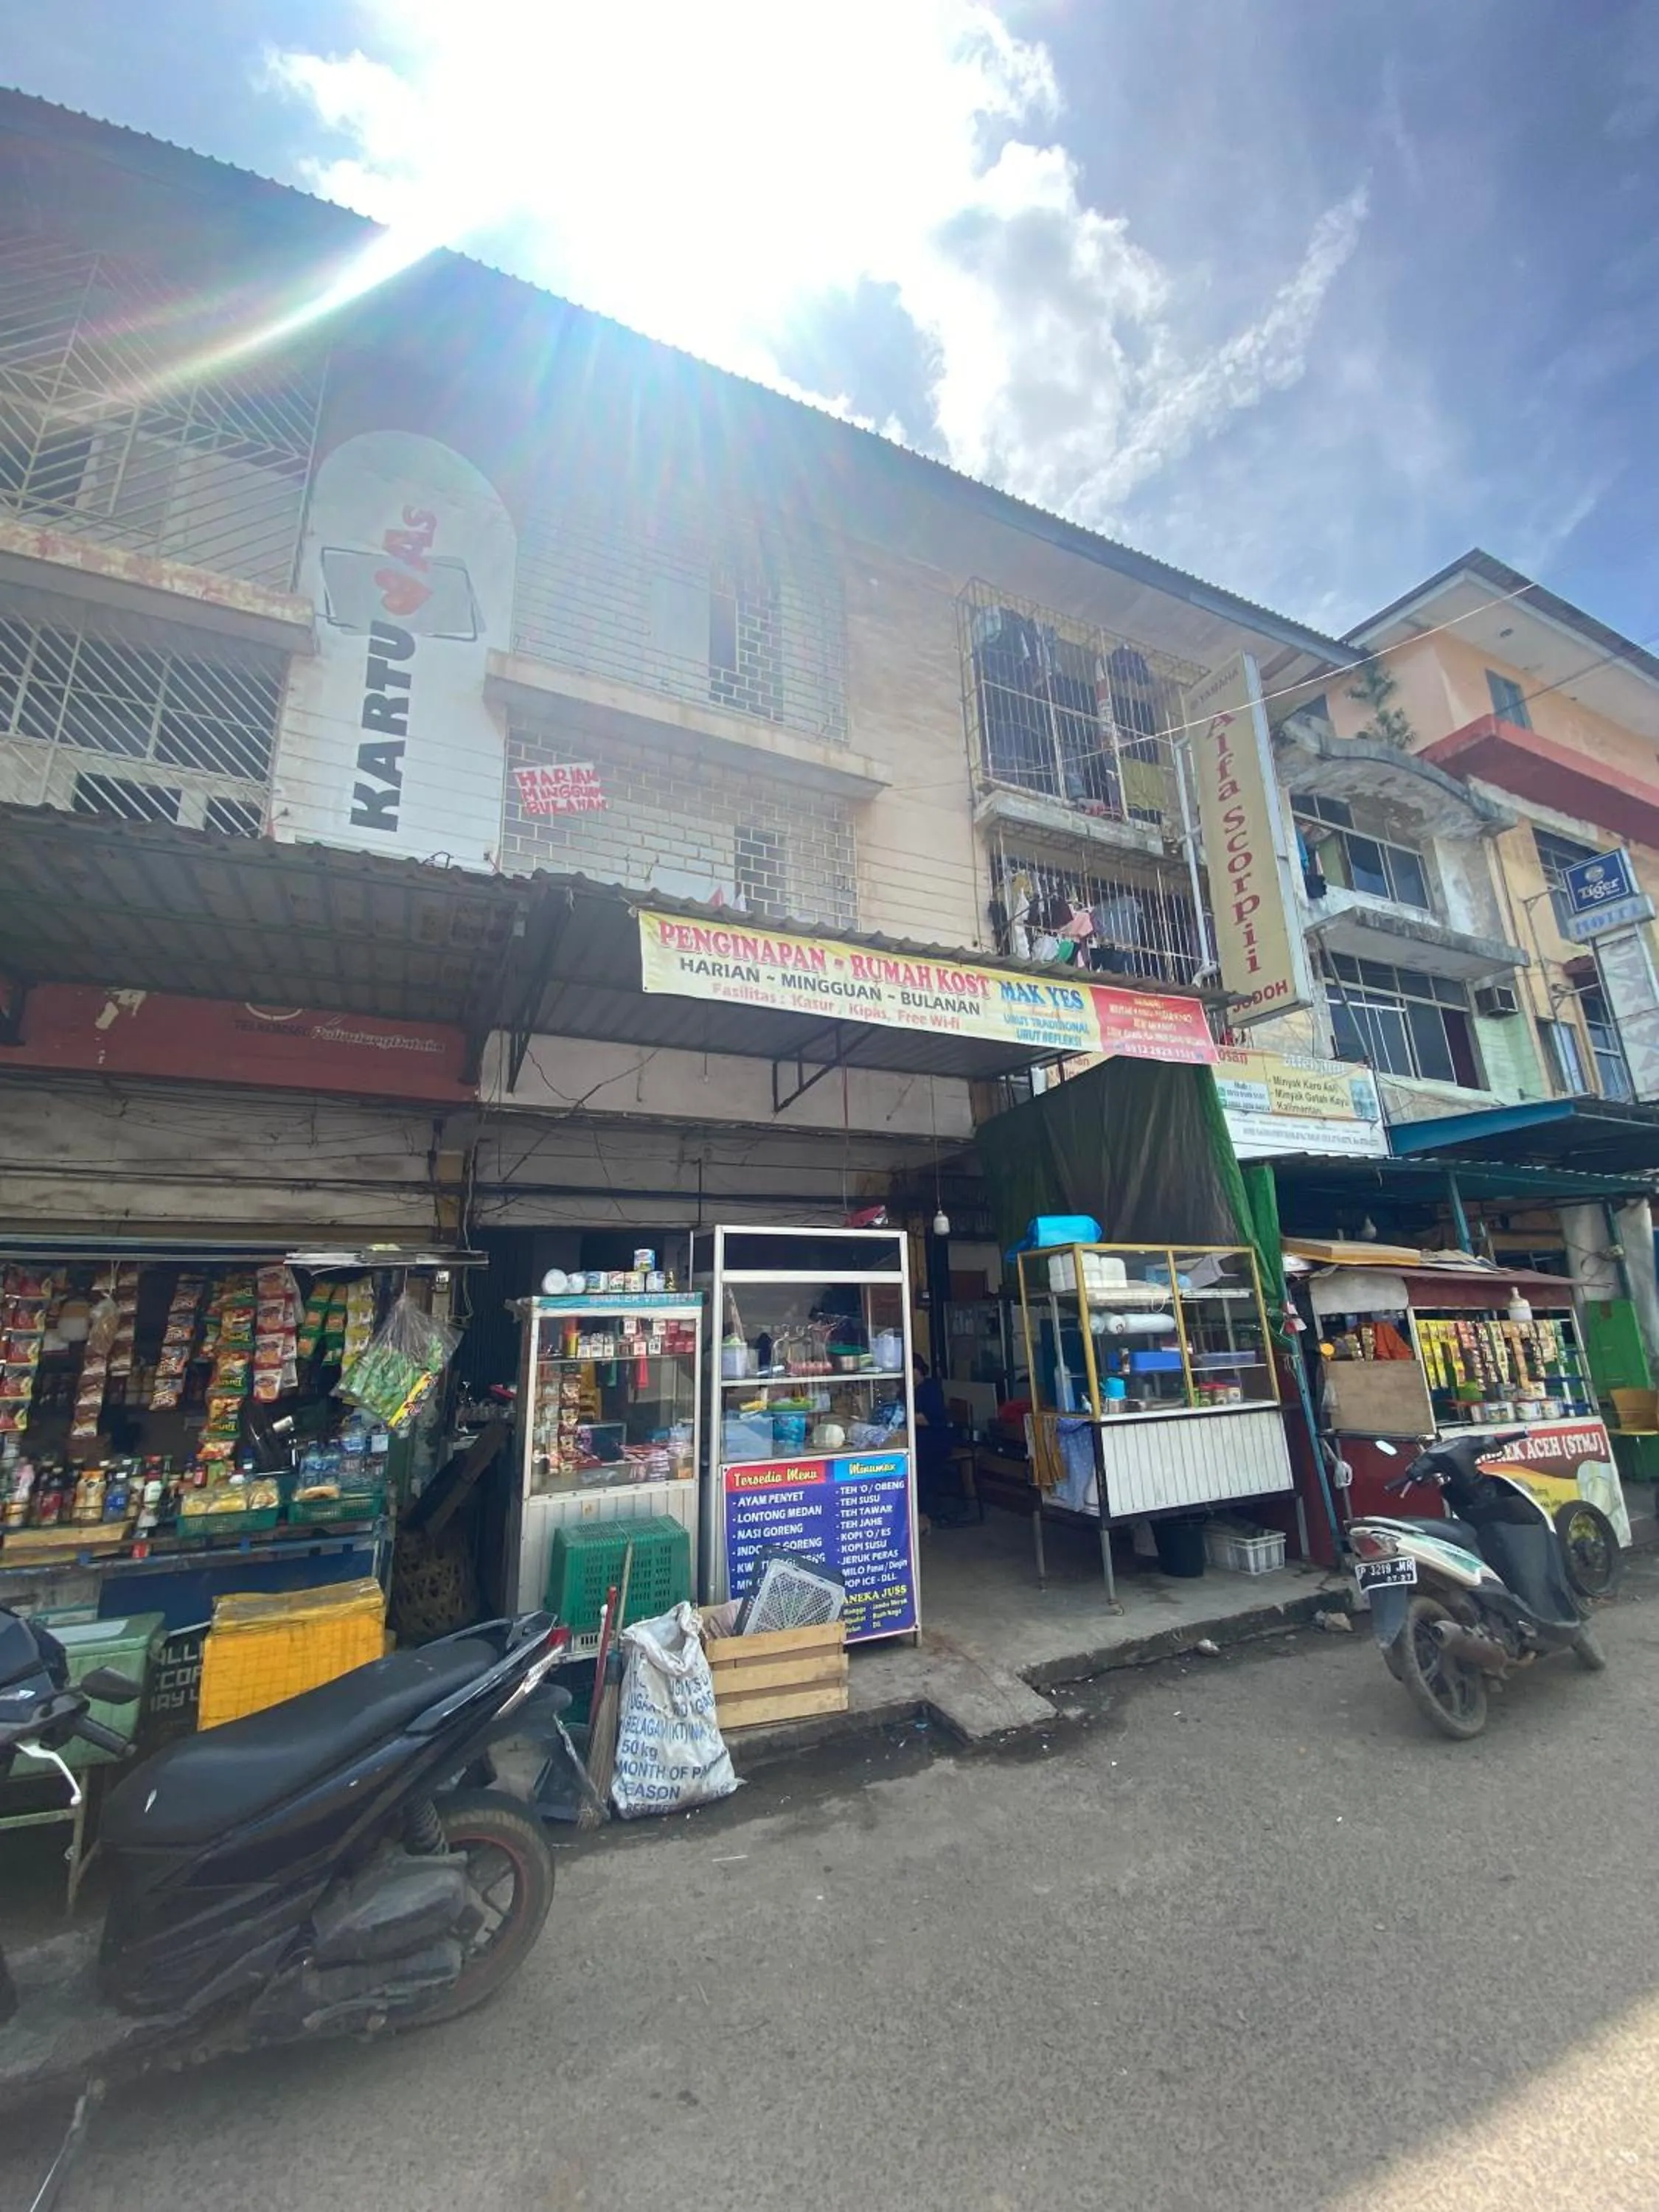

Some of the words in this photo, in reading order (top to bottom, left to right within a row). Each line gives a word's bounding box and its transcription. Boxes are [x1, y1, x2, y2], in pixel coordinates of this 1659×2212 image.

[1200, 666, 1239, 703] YAMAHA
[350, 619, 416, 832] KARTU
[1206, 709, 1242, 803] Alfa
[517, 766, 599, 785] HARIAN
[521, 785, 604, 801] MINGGUAN
[526, 796, 608, 814] BULANAN
[1222, 804, 1262, 974] Scorpii
[1577, 877, 1620, 899] Tiger
[658, 920, 827, 974] PENGINAPAN
[849, 953, 933, 992] RUMAH
[936, 967, 992, 1000] KOST
[999, 981, 1046, 1006] MAK
[1044, 986, 1085, 1011] YES
[679, 957, 760, 983] HARIAN
[782, 972, 883, 1001] MINGGUAN
[900, 991, 980, 1015] BULANAN
[712, 982, 776, 1004] Fasilitas
[897, 1009, 928, 1025] Free
[1015, 1027, 1040, 1040] URUT
[1273, 1074, 1301, 1089] Minyak
[1275, 1088, 1304, 1102] Minyak
[1527, 1436, 1562, 1459] ACEH
[734, 1470, 782, 1487] Tersedia
[787, 1468, 818, 1482] Menu
[841, 1486, 858, 1495] TEH
[874, 1480, 905, 1492] OBENG
[737, 1495, 768, 1508] AYAM
[768, 1491, 804, 1504] PENYET
[841, 1498, 858, 1506] TEH
[859, 1494, 880, 1505] SUSU
[737, 1509, 785, 1523] LONTONG
[787, 1506, 822, 1518] MEDAN
[841, 1508, 858, 1518] TEH
[860, 1505, 893, 1516] TAWAR
[737, 1527, 762, 1540] NASI
[762, 1523, 804, 1537] GORENG
[841, 1520, 858, 1530] TEH
[858, 1517, 883, 1527] JAHE
[841, 1531, 862, 1542] KOPI
[841, 1542, 863, 1554] KOPI
[865, 1539, 887, 1551] SUSU
[841, 1554, 870, 1565] JERUK
[842, 1566, 865, 1576] MILO
[862, 1576, 876, 1587] ICE
[881, 1573, 897, 1583] DLL
[841, 1590, 880, 1605] ANEKA
[619, 1760, 665, 1780] MONTH
[669, 1766, 689, 1781] OF
